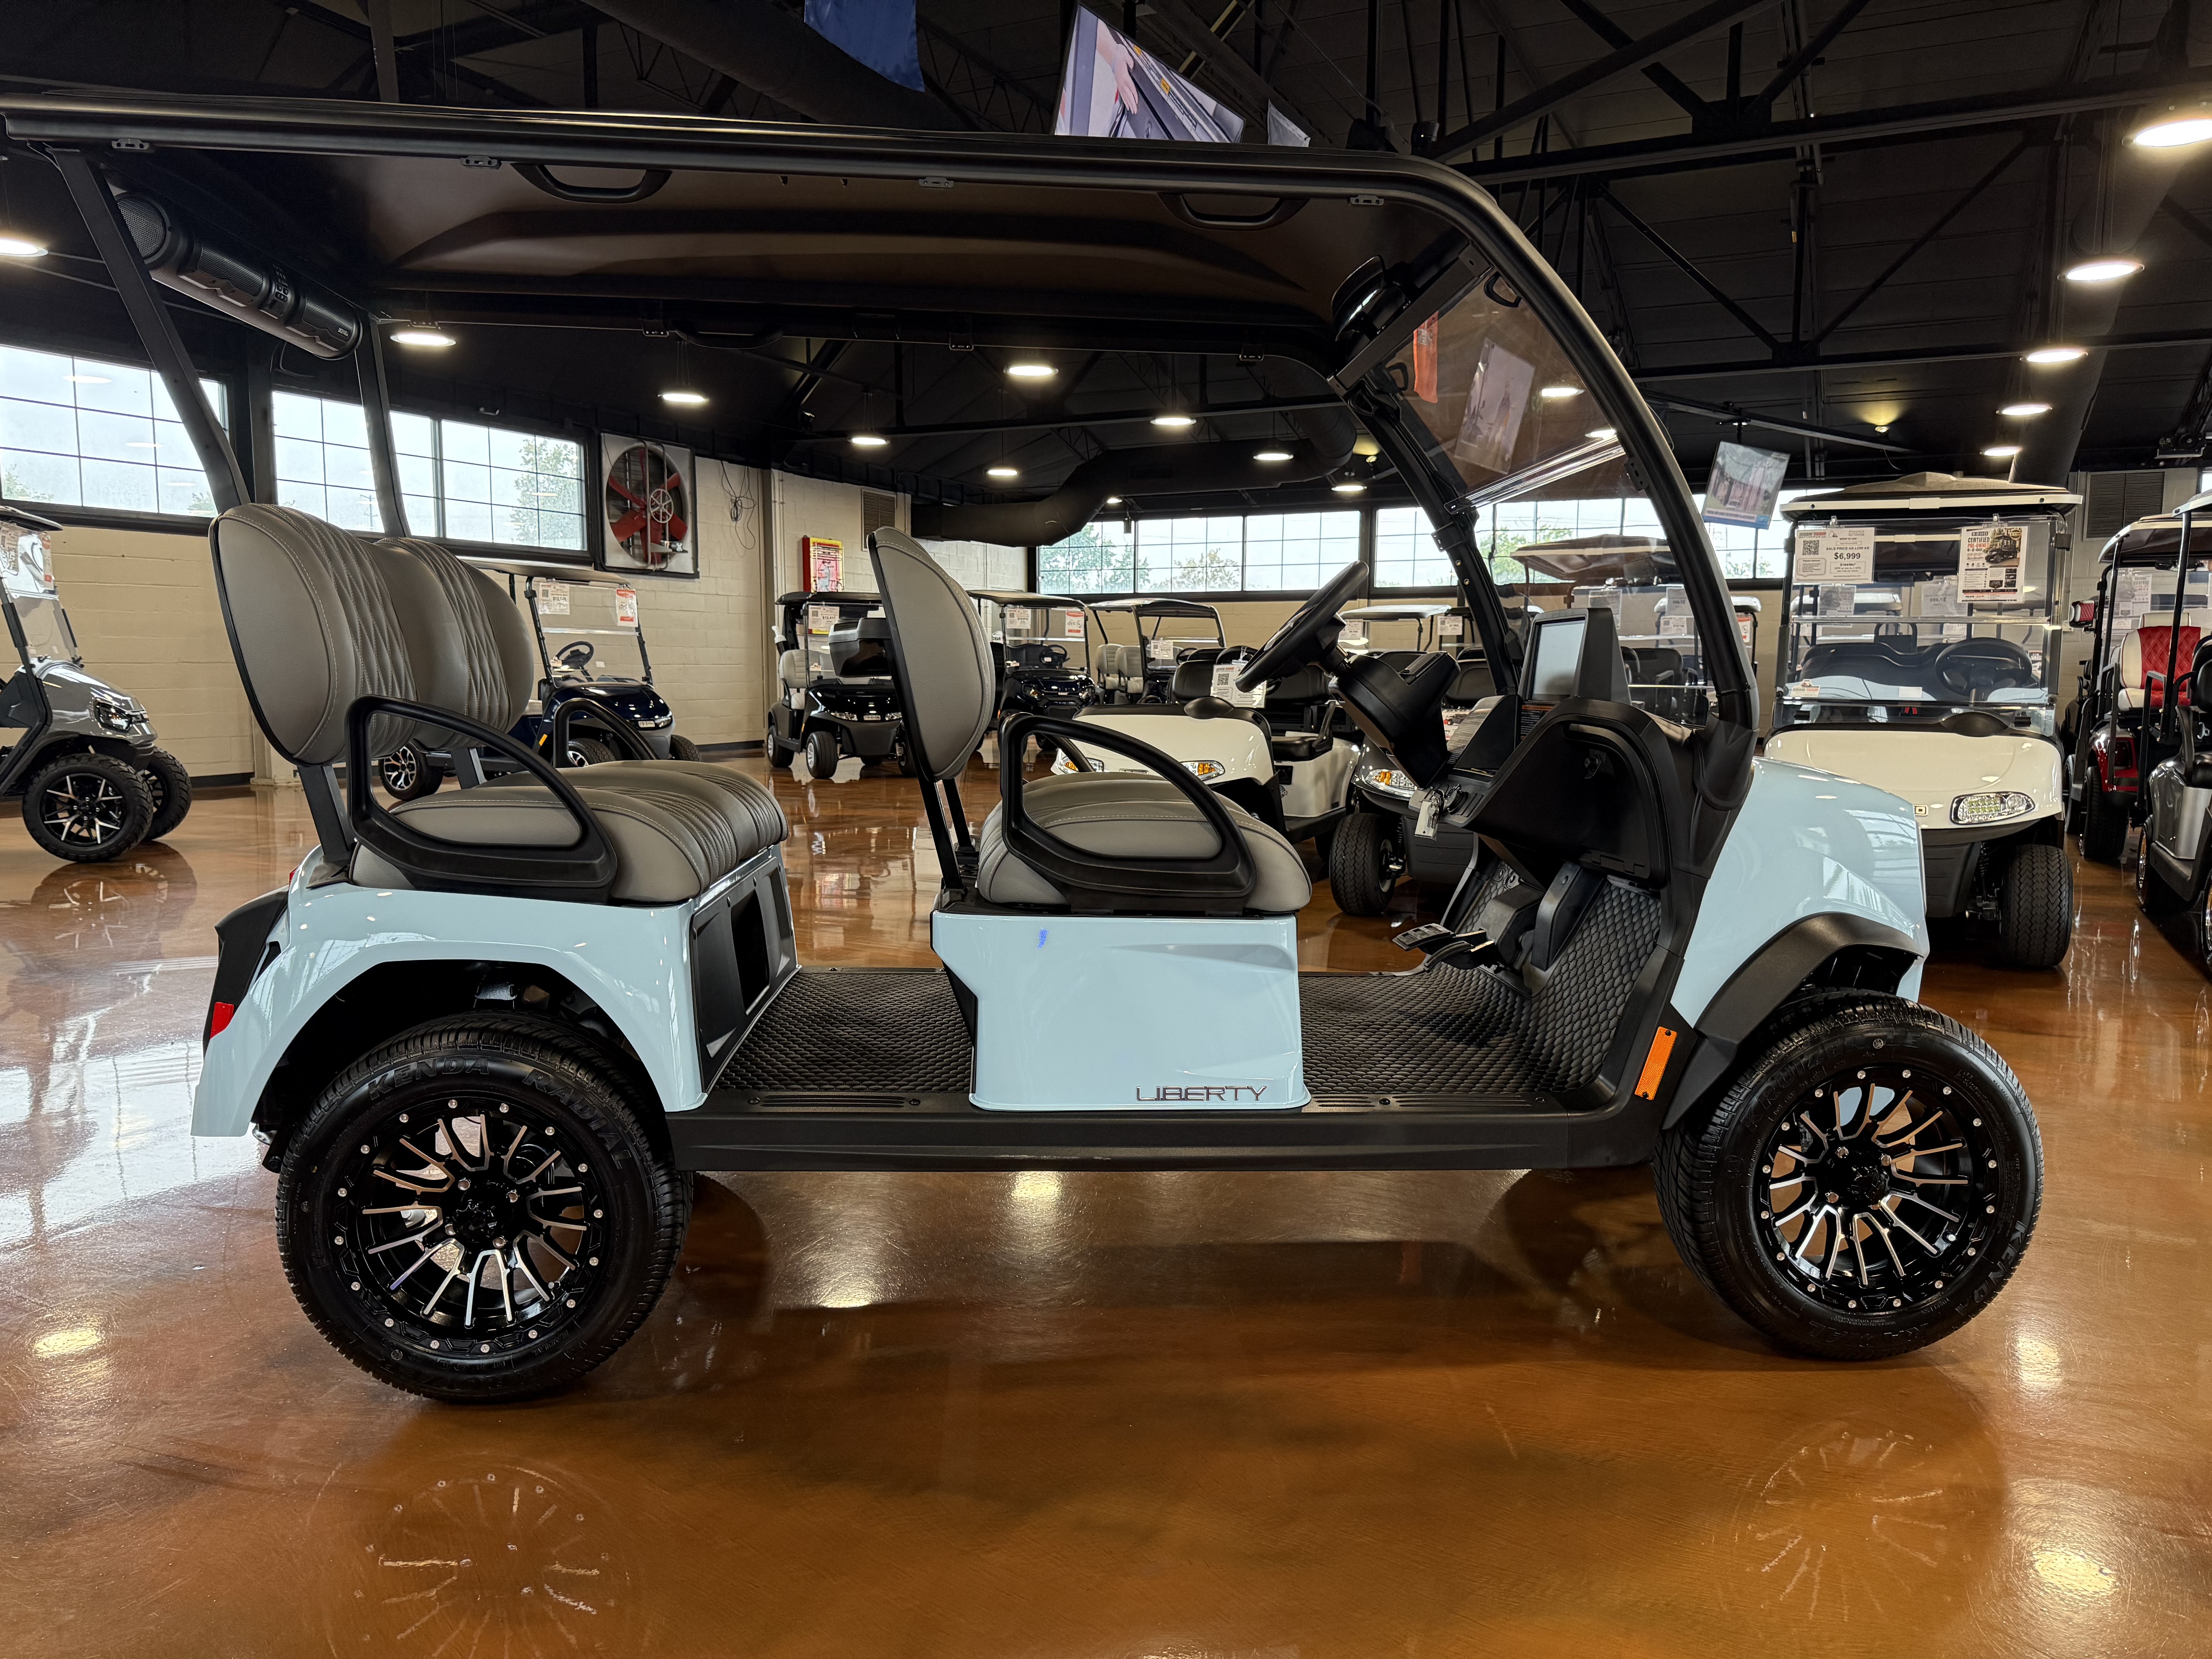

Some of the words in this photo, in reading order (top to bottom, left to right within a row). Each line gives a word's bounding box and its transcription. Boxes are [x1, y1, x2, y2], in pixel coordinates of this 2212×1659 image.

[368, 1056, 489, 1100] KENDA
[522, 1068, 632, 1169] RADIAL
[1136, 1086, 1267, 1101] LIBERTY
[1954, 1220, 2027, 1319] KENDA
